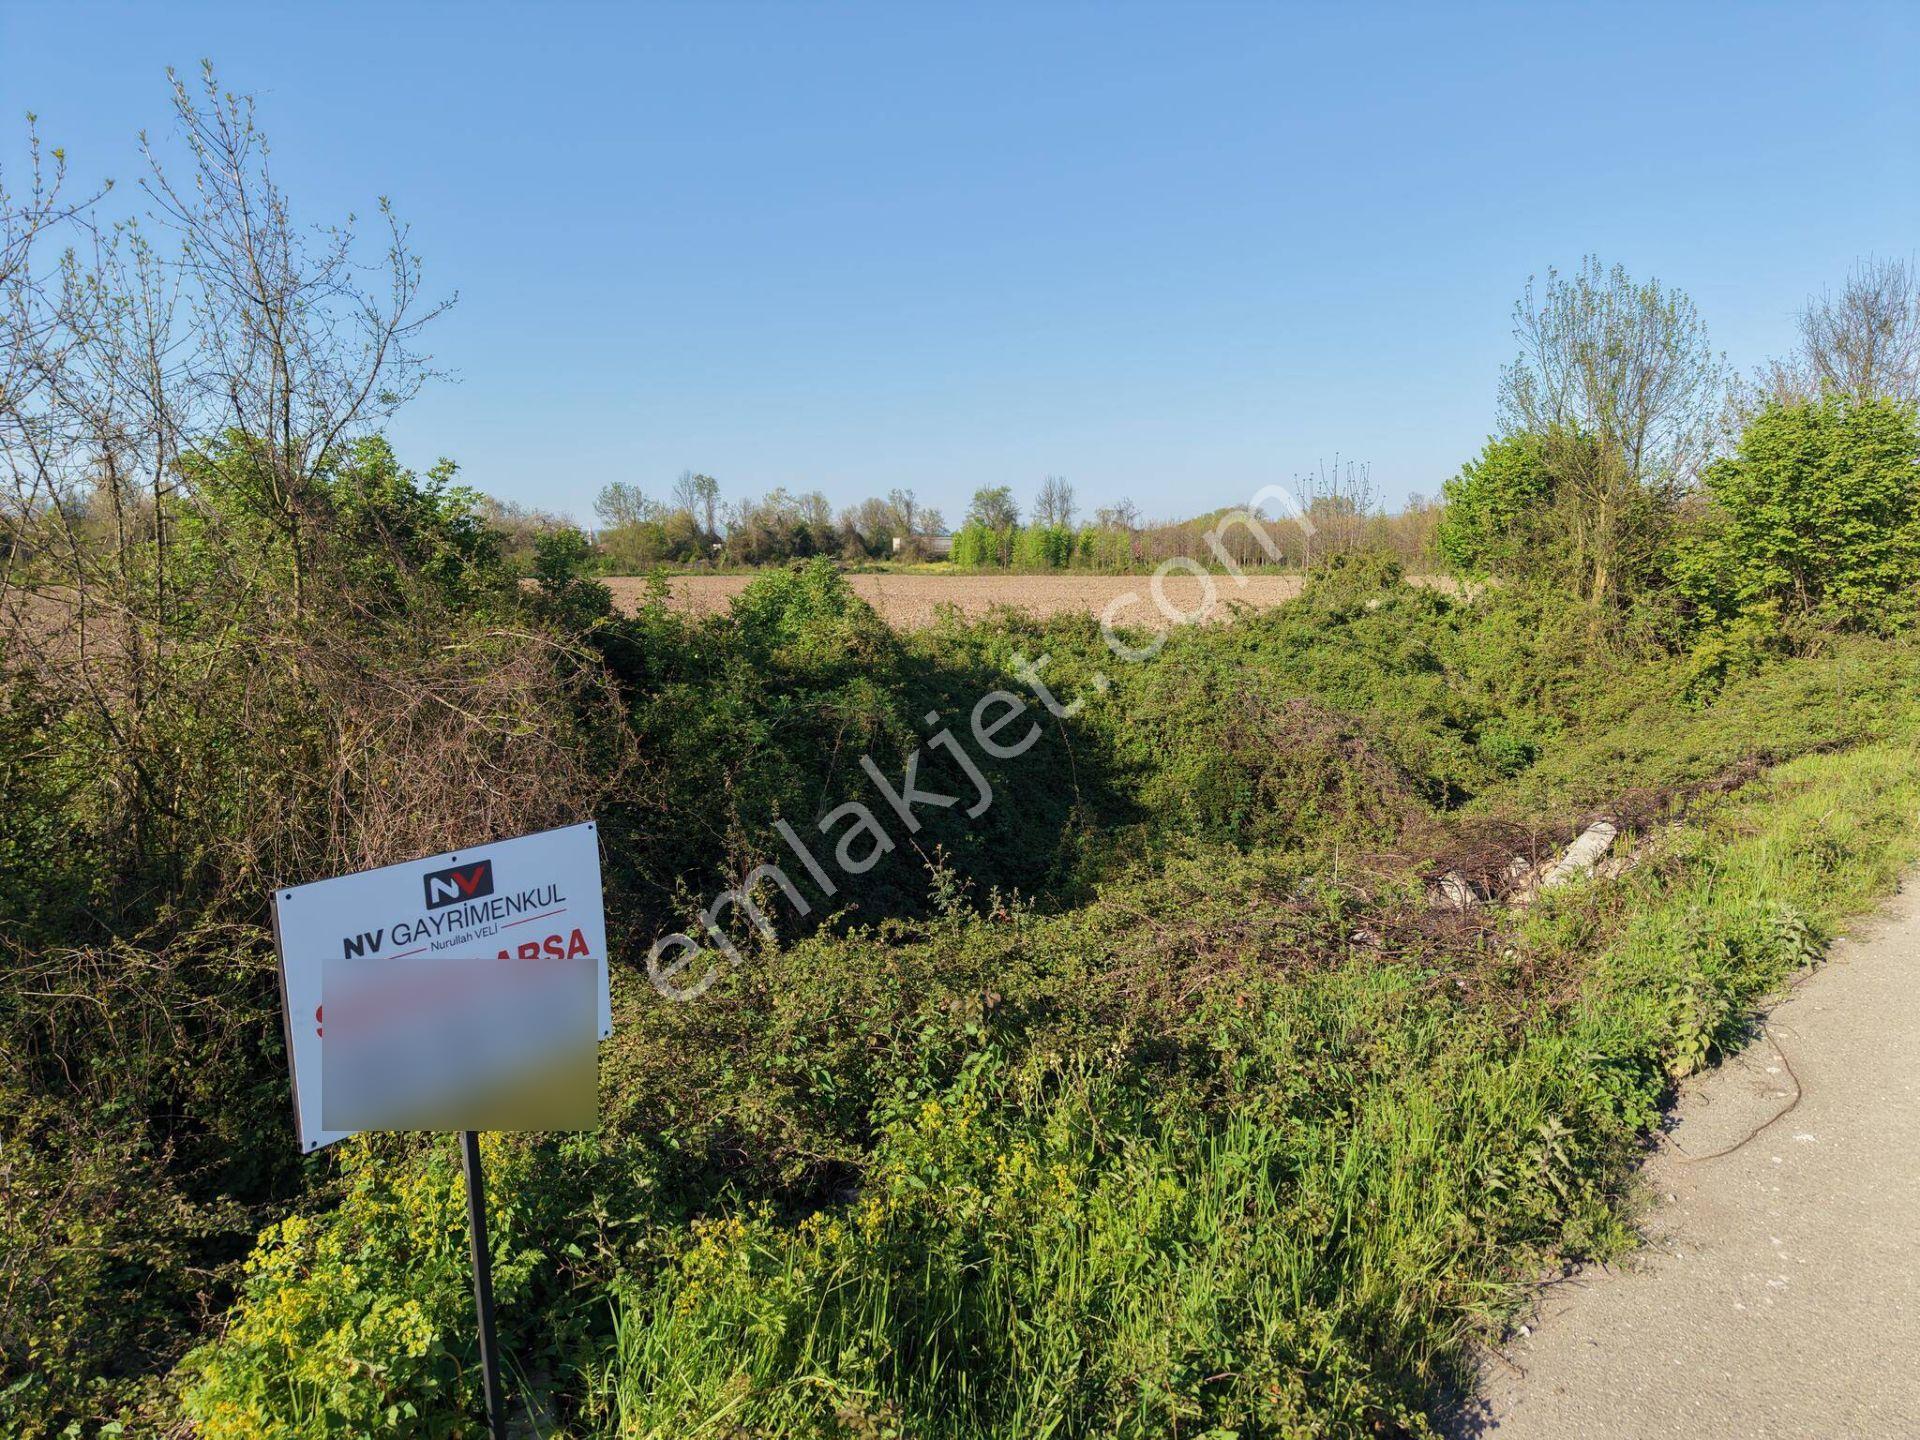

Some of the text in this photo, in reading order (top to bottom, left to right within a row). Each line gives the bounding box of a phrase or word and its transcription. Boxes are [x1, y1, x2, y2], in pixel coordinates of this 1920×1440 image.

[430, 864, 486, 904] NV
[343, 883, 567, 960] NV GAYRİMENKUL
[431, 922, 498, 952] Nurullah VELİ
[497, 928, 590, 960] RSA
